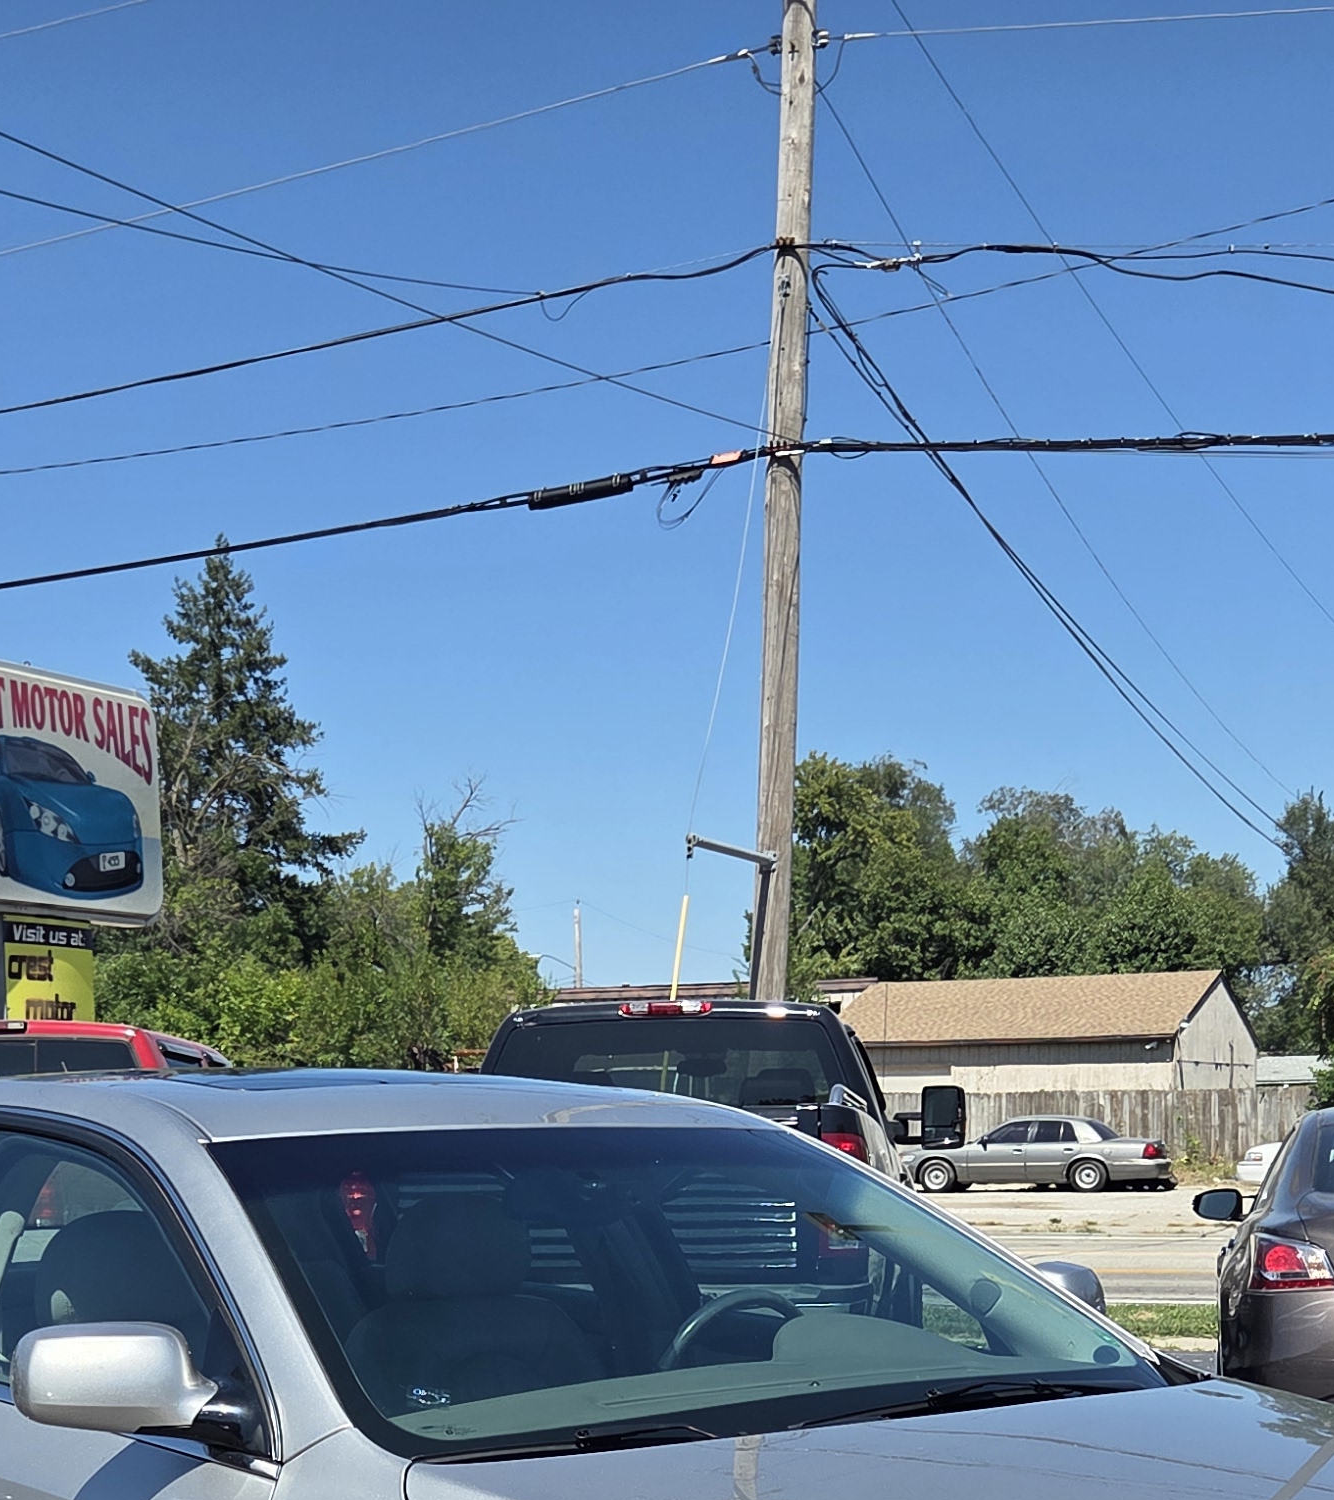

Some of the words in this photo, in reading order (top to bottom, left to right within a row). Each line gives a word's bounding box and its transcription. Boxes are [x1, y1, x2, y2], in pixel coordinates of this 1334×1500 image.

[10, 679, 89, 743] MOTOR
[92, 697, 153, 786] SALES
[12, 924, 45, 943] Visit
[49, 930, 68, 945] us
